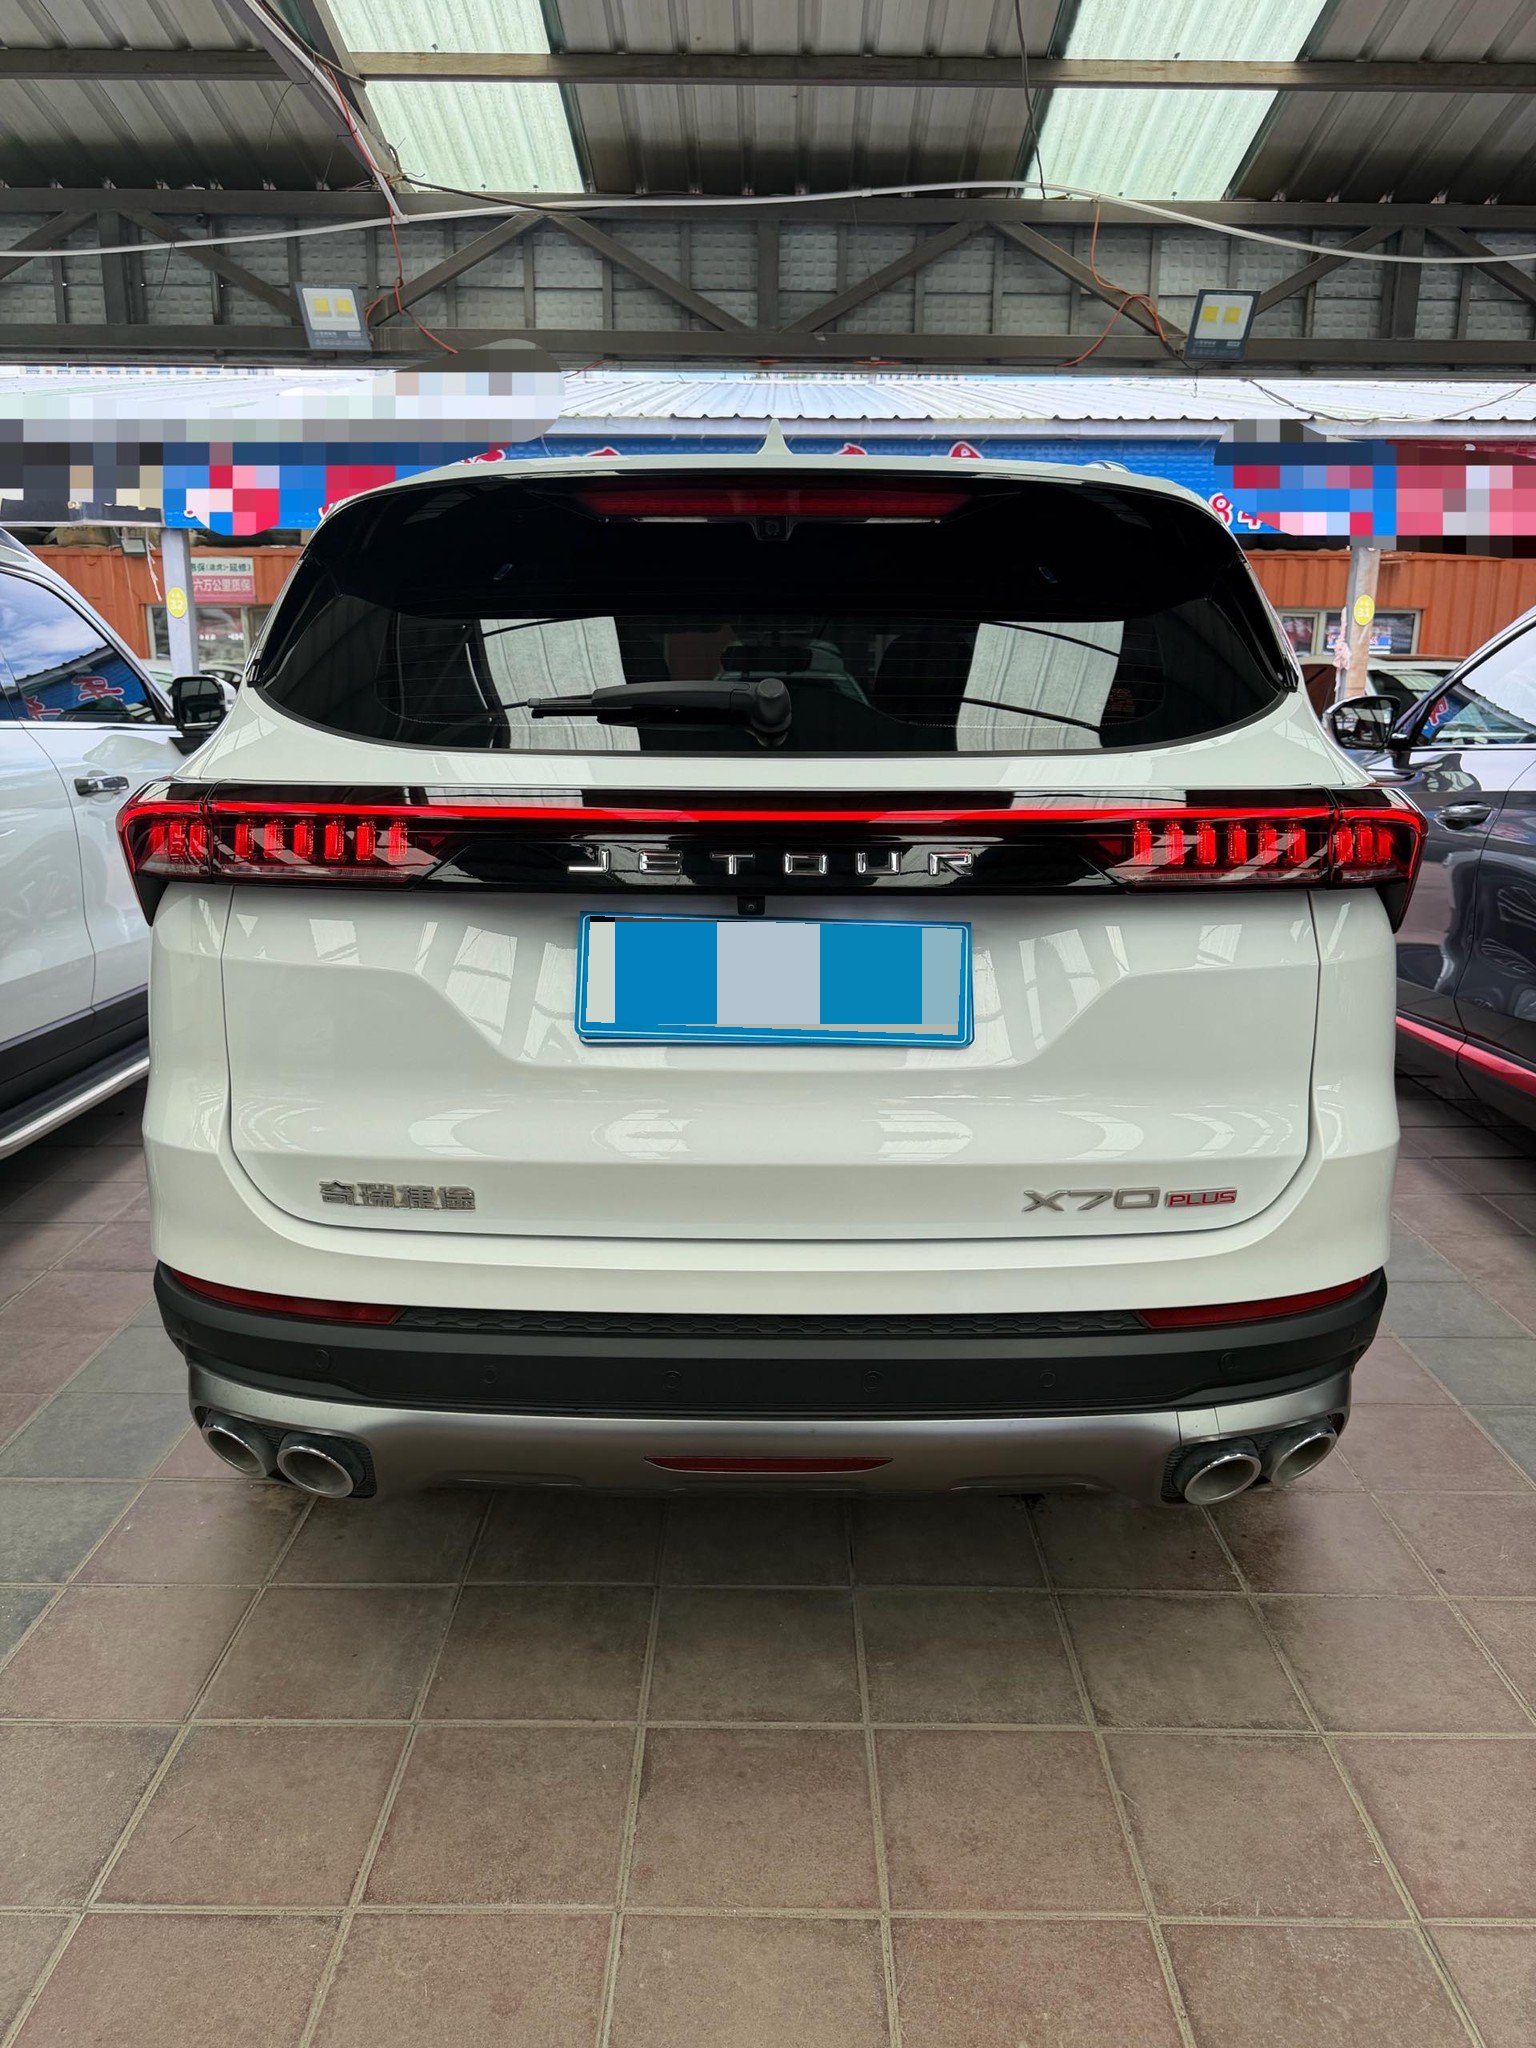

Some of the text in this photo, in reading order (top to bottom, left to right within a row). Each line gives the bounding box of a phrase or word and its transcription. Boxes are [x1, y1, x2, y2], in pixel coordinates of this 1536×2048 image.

[567, 850, 974, 876] JETOUR
[1021, 1187, 1237, 1211] X70 PLUS
